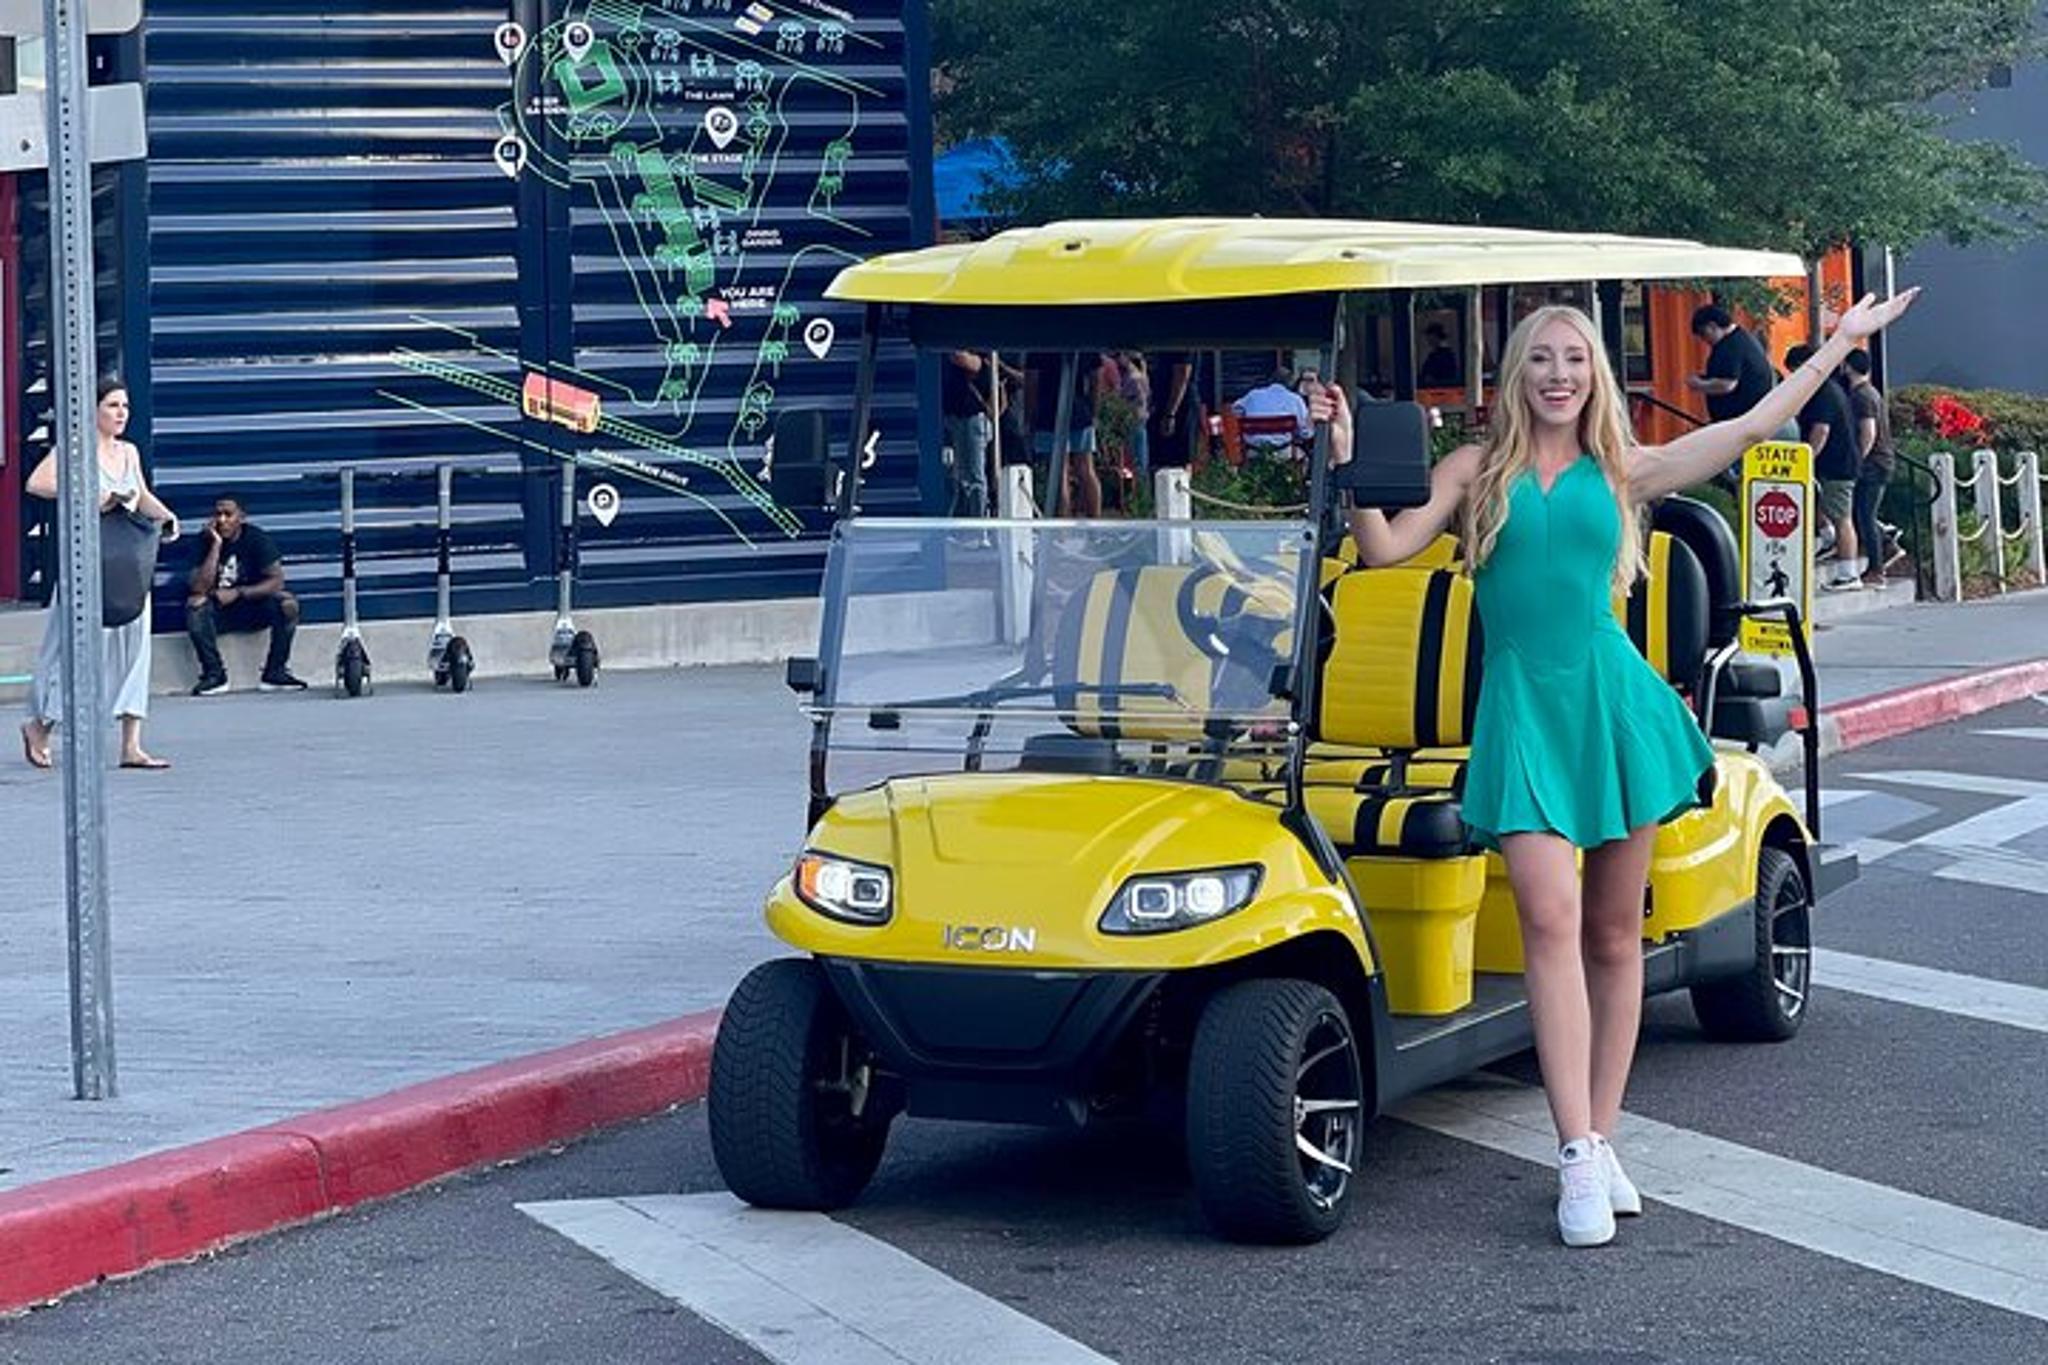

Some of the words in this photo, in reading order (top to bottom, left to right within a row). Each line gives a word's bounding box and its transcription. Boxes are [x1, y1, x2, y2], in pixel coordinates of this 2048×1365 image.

[684, 91, 703, 100] THE
[705, 91, 735, 100] LAWN
[719, 286, 747, 299] YOU
[748, 286, 775, 297] ARE
[730, 298, 767, 309] HERE
[1755, 446, 1799, 464] STATE
[1760, 463, 1792, 478] LAW
[1757, 506, 1797, 525] STOP
[943, 924, 1037, 952] ICON
